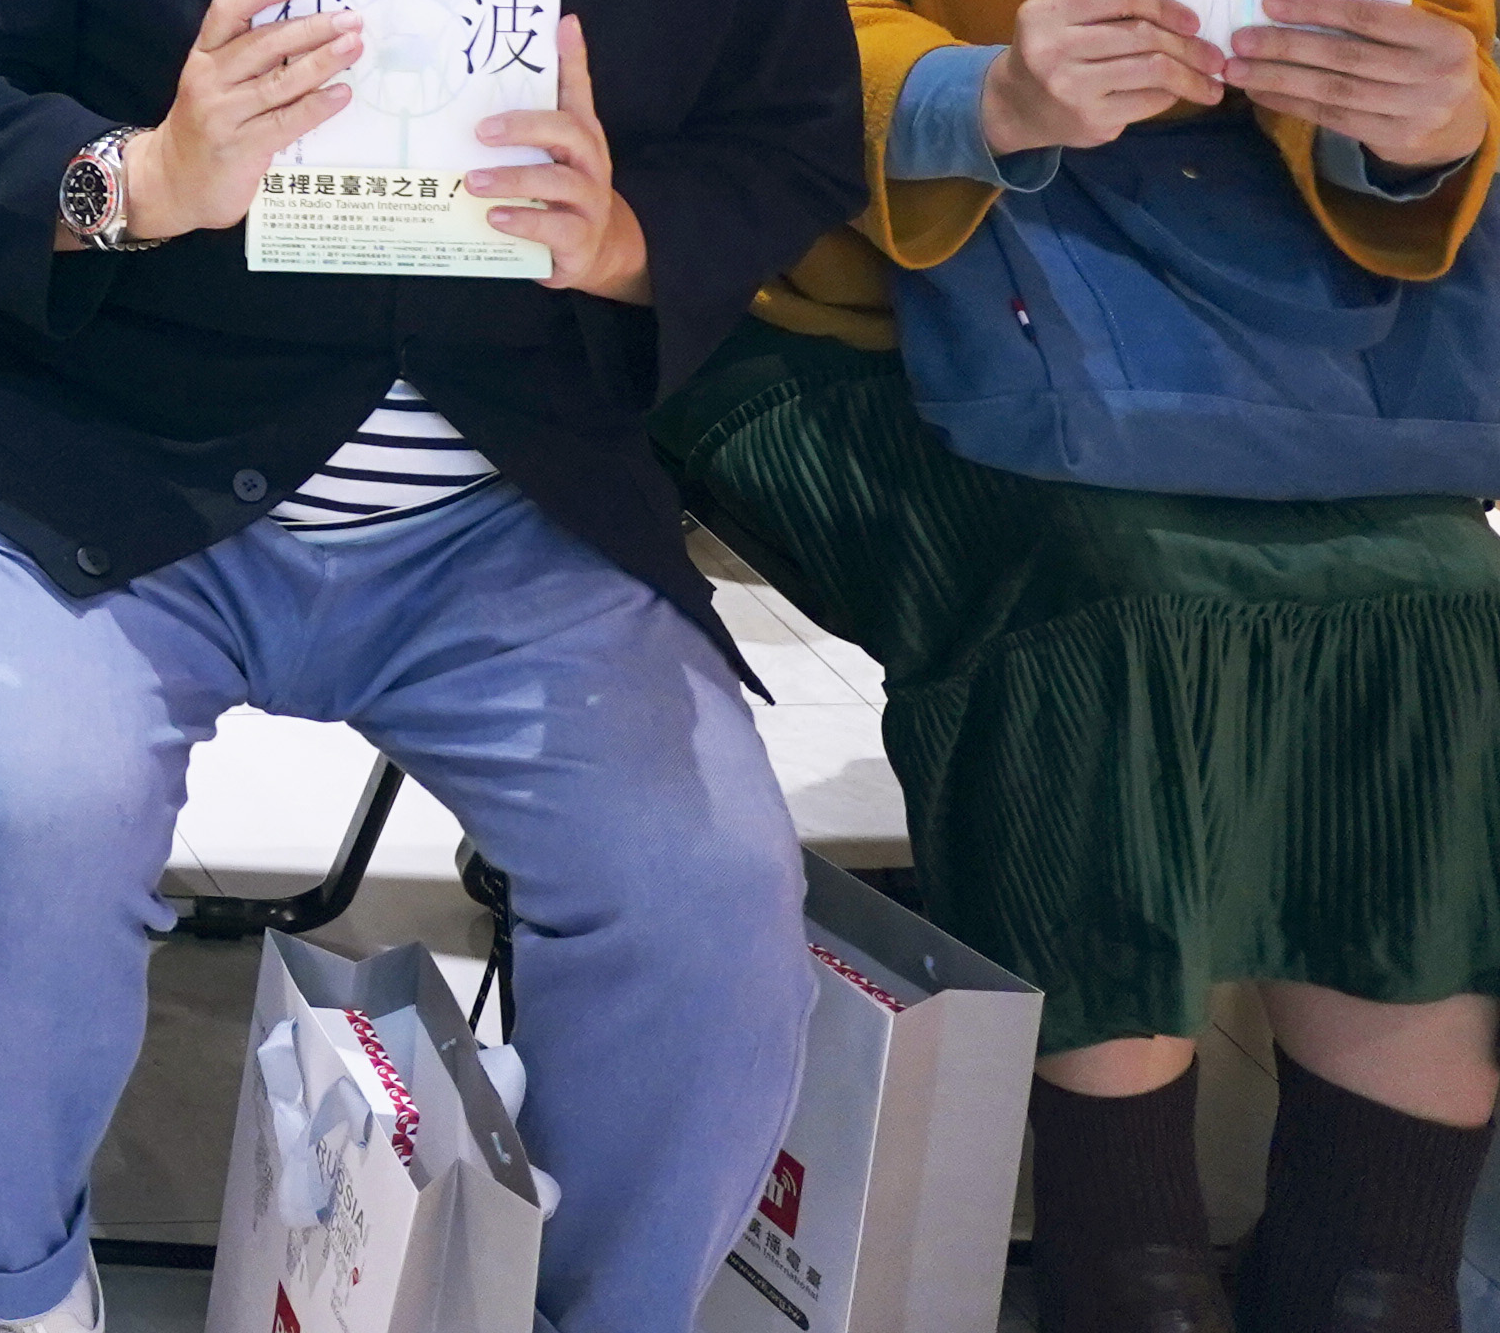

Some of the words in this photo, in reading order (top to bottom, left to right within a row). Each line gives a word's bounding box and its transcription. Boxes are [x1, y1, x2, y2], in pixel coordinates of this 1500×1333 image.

[262, 197, 286, 209] This
[299, 198, 332, 210] Radio
[335, 199, 375, 212] Taiwan
[377, 200, 451, 214] International
[315, 1137, 364, 1239] RUSSIA
